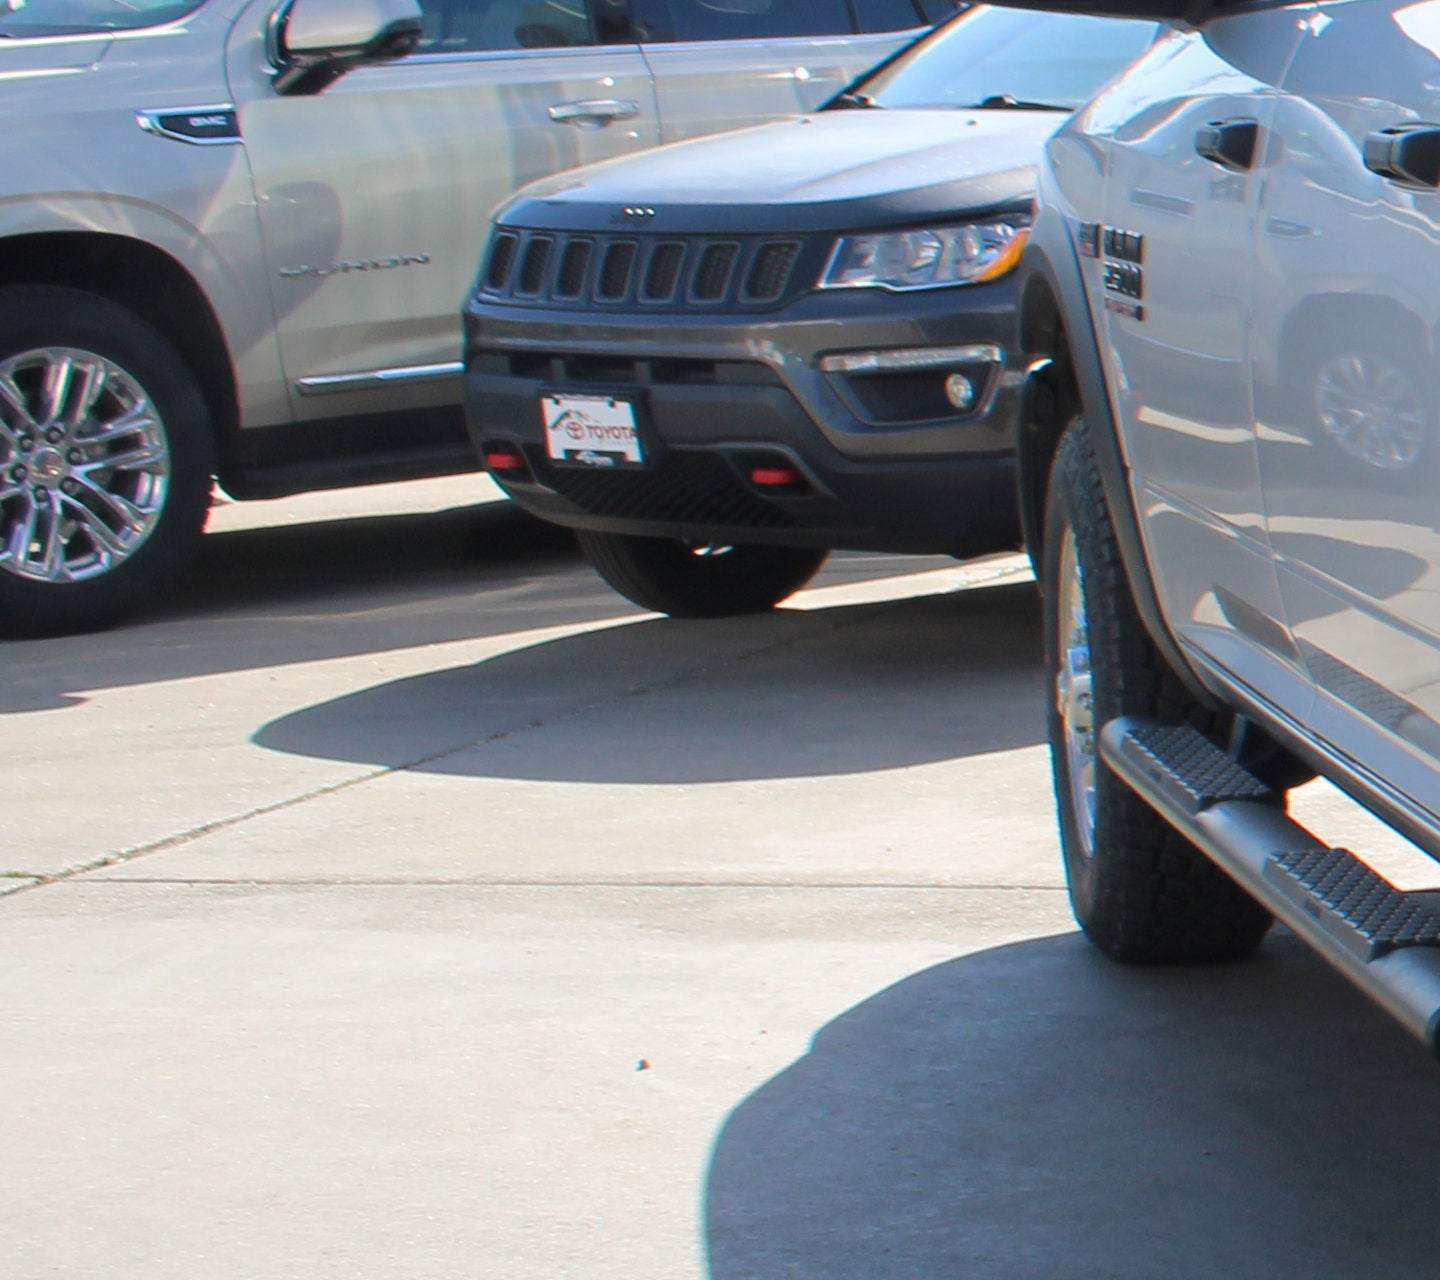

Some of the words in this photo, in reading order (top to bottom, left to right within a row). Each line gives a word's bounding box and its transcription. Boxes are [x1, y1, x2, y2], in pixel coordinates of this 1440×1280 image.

[189, 116, 228, 128] GMC
[280, 252, 431, 277] YUKON
[586, 424, 637, 440] TOYOTA
